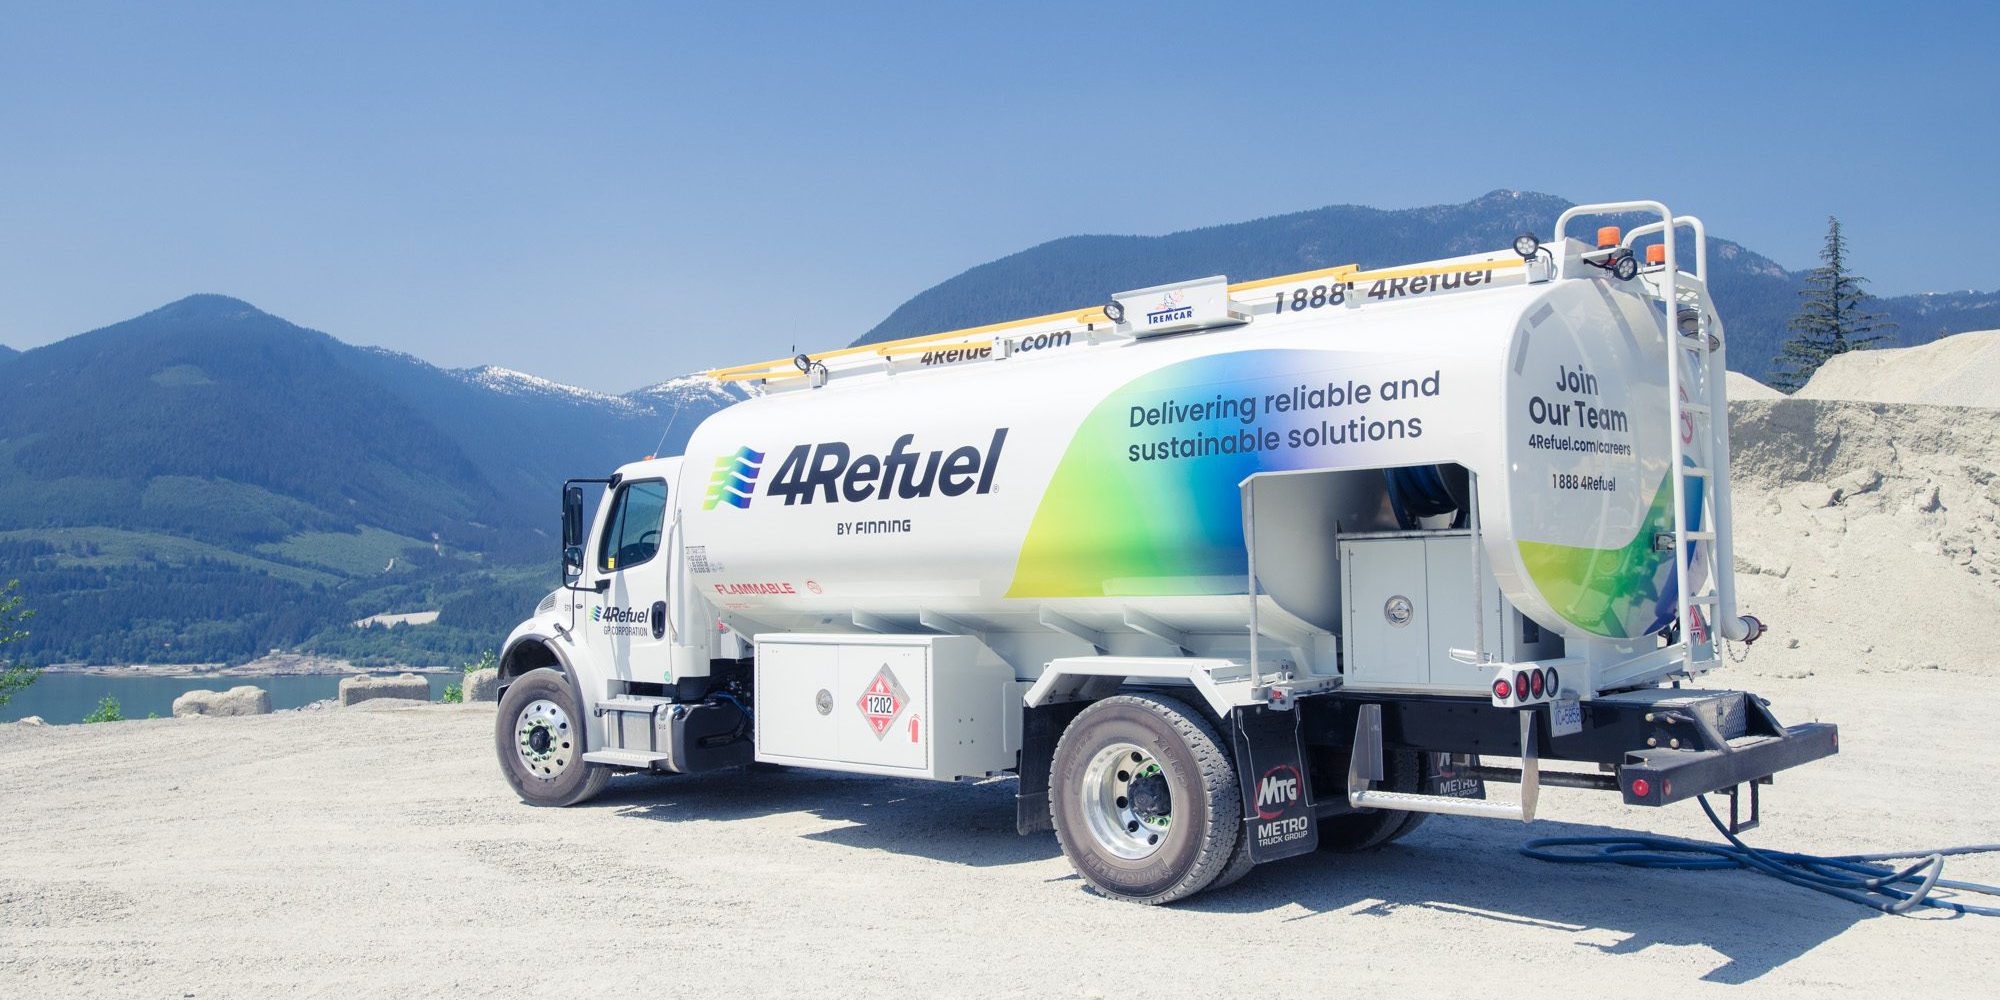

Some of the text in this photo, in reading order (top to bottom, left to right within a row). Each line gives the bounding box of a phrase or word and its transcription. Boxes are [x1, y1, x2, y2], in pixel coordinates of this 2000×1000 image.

[1275, 291, 1285, 315] 1
[1290, 282, 1346, 312] 888
[1147, 306, 1193, 325] TREMCAR
[1556, 364, 1598, 395] Join
[1129, 370, 1441, 428] Delivering reliable and
[1529, 396, 1628, 432] Our Team
[1128, 416, 1423, 462] sustainable solutions
[1528, 434, 1631, 456] 4Refuel.com/careers
[767, 428, 1009, 506] 4Refuel
[1559, 474, 1579, 490] 888
[1580, 475, 1616, 492] 4Refuel
[837, 519, 911, 535] BY FINNING
[714, 582, 796, 595] FLAMMABLE
[602, 606, 650, 623] 4Refuel
[612, 627, 648, 637] CORPORATION
[868, 696, 892, 714] 1202
[877, 720, 883, 730] 3
[1258, 775, 1297, 807] MTG
[1258, 816, 1308, 839] METRO
[1259, 830, 1308, 847] TRUCK GROUP
